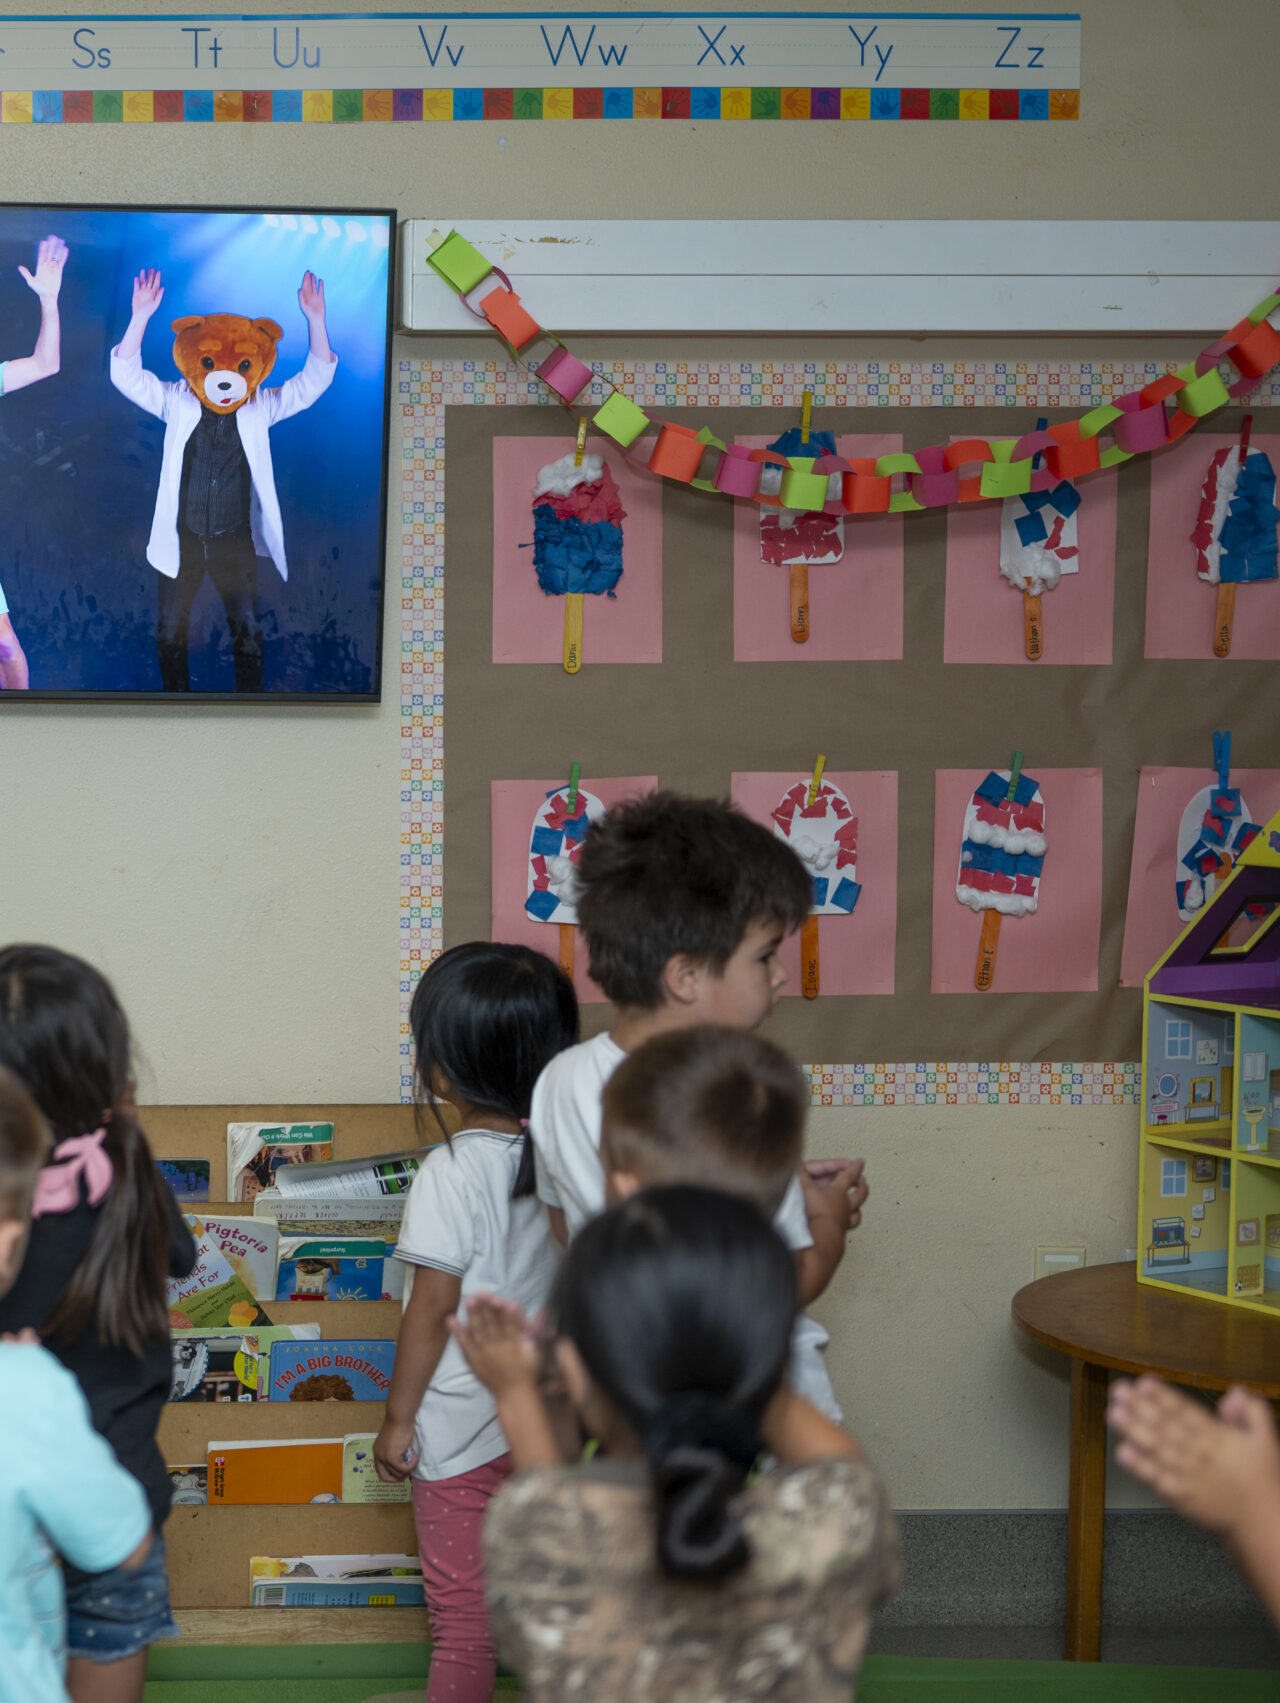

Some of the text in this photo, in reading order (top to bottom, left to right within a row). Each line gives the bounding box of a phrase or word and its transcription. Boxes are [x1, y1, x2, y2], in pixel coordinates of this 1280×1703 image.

[73, 28, 111, 69] Ss
[181, 28, 223, 69] Tt
[273, 27, 320, 69] Uu
[418, 25, 465, 67] Vv
[540, 25, 628, 67] Ww
[697, 25, 745, 66] Xx
[849, 25, 894, 82] Yy
[995, 27, 1045, 68] Zz
[804, 960, 817, 994] Isaac
[205, 1222, 268, 1253] Pigtoria
[220, 1240, 247, 1257] Pea
[179, 1270, 219, 1303] Are For
[274, 1354, 392, 1391] I'M A BIG BROTHER
